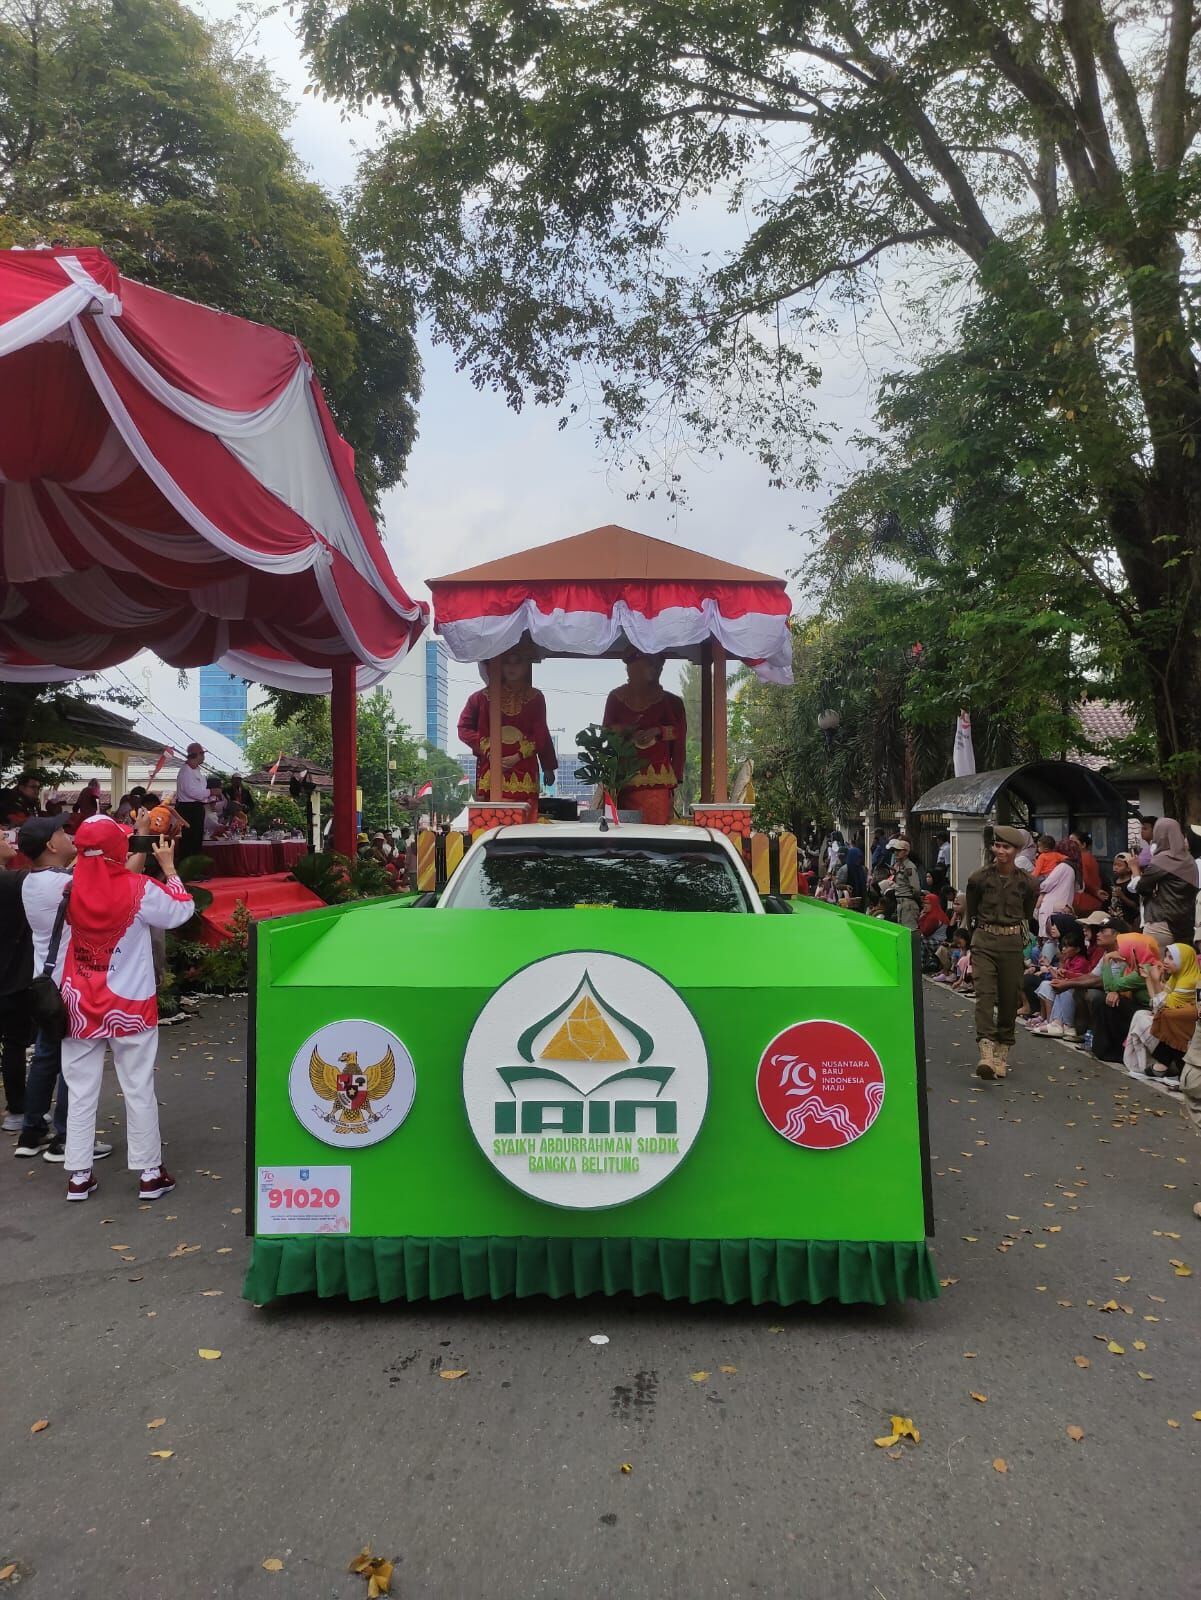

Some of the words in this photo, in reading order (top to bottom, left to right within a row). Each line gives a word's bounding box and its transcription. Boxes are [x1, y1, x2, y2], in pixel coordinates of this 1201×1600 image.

[821, 1060, 870, 1068] NUSANTARA
[770, 1054, 817, 1096] 79
[822, 1084, 845, 1092] MAJU
[494, 1100, 677, 1134] IAIN
[492, 1137, 536, 1155] SYAIKH
[539, 1136, 632, 1153] ABDURRAHMAN
[528, 1155, 577, 1174] BANGKA
[581, 1156, 640, 1173] BELITUNG
[268, 1188, 341, 1209] 91020
